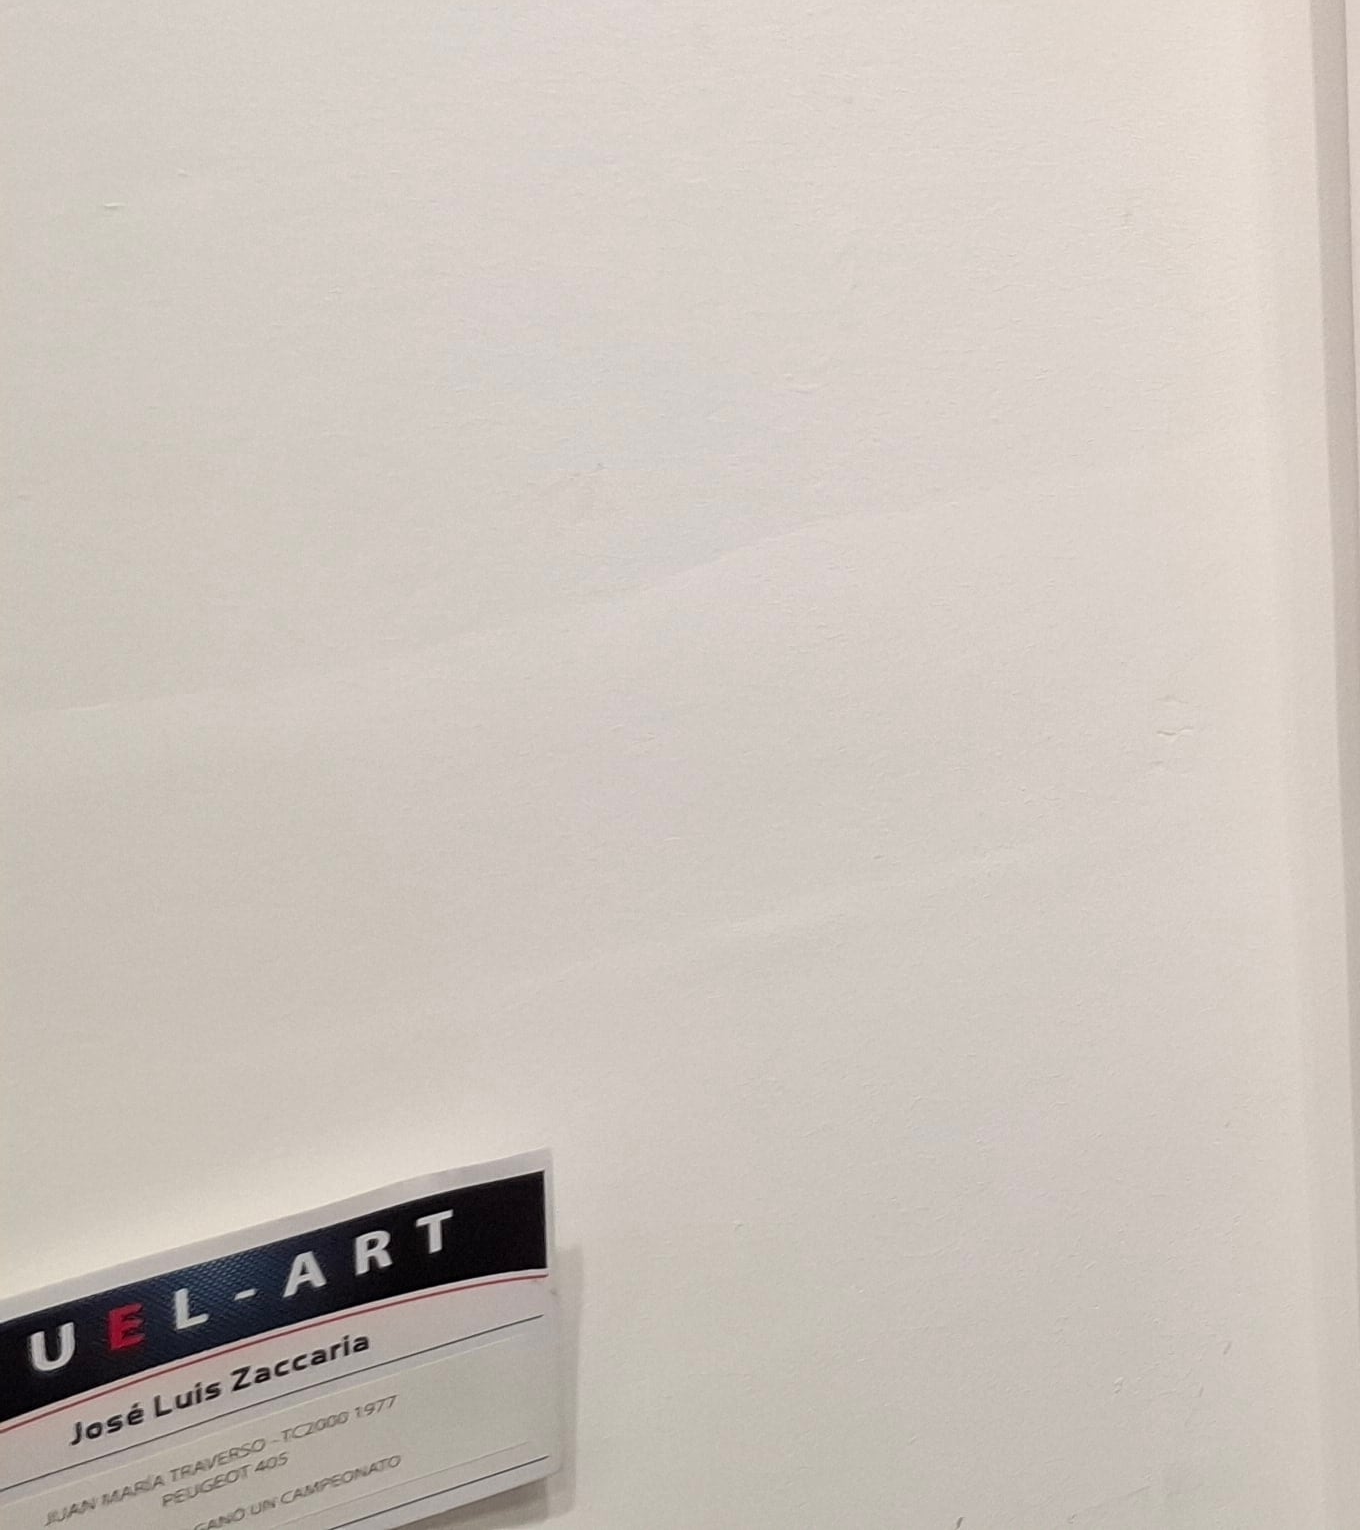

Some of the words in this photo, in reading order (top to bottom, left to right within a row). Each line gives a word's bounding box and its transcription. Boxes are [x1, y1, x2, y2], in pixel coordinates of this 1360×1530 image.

[69, 1402, 144, 1446] José
[155, 1378, 221, 1419] Luis
[231, 1333, 370, 1392] Zaccaria
[169, 1438, 266, 1482] TRAVERSO
[354, 1395, 398, 1418] 1977
[161, 1464, 250, 1507] PEUGEOT
[254, 1451, 289, 1473] 405
[281, 1455, 402, 1505] CAMPEONATO
